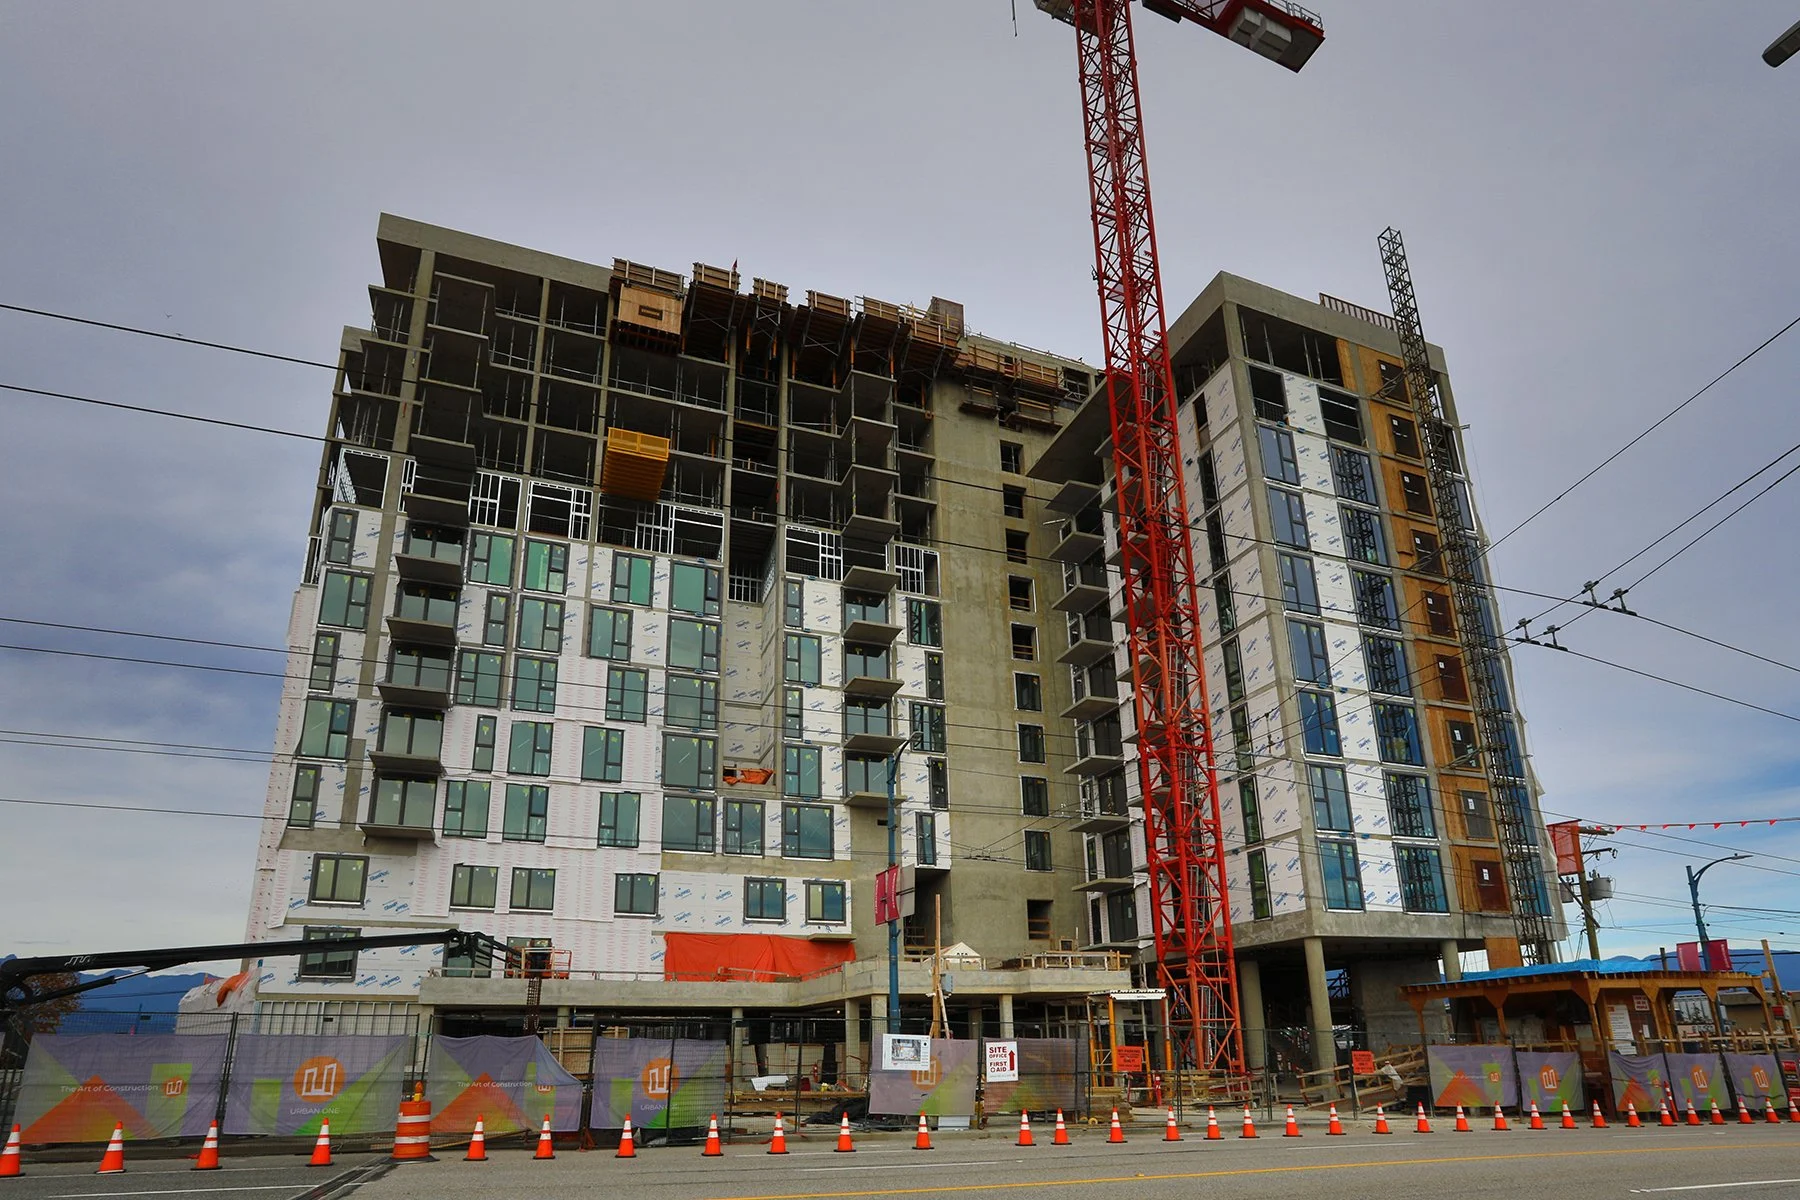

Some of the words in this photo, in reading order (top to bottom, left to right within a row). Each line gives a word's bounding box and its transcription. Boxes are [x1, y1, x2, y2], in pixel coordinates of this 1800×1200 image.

[989, 1046, 1007, 1054] SITE
[61, 1085, 76, 1093] The
[103, 1084, 159, 1092] Construction
[289, 1107, 320, 1115] URBAN
